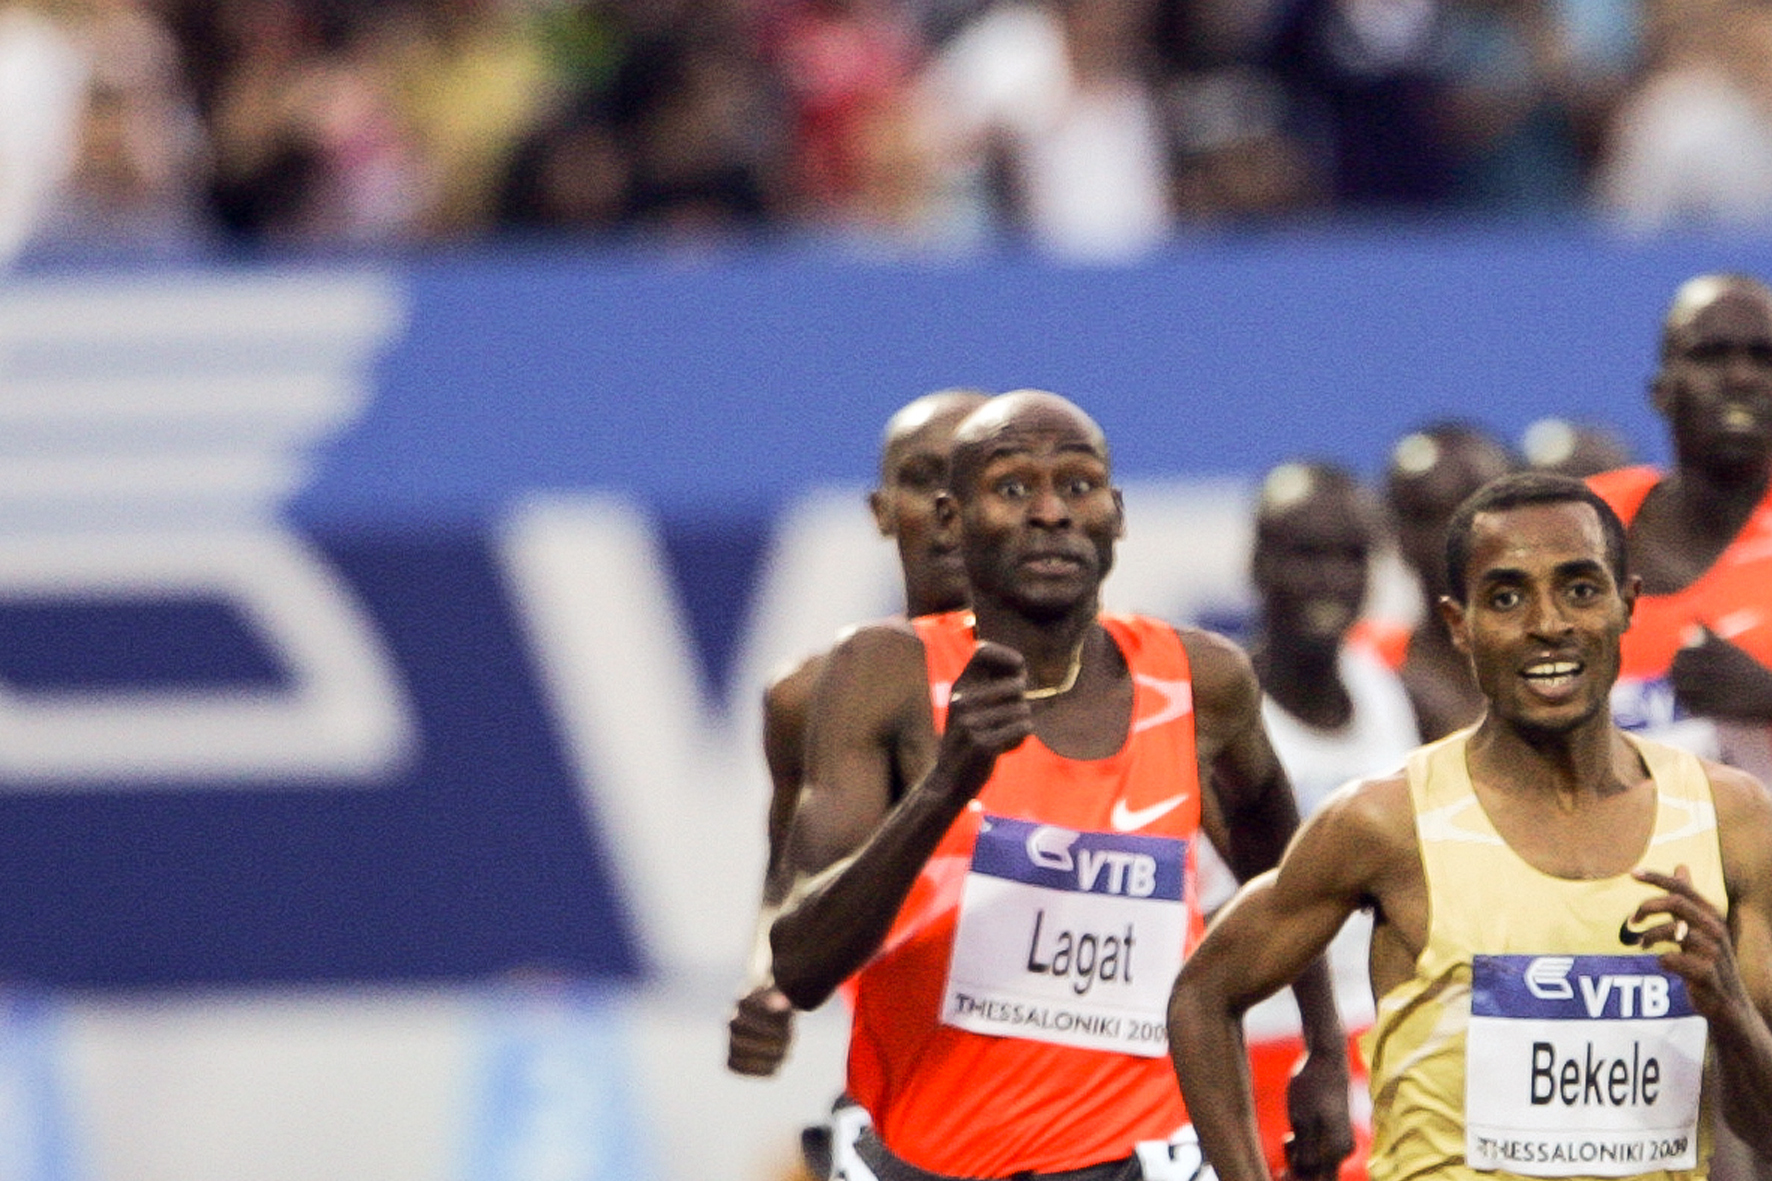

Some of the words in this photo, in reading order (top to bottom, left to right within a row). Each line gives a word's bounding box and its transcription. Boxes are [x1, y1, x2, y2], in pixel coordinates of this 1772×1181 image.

[1077, 849, 1157, 897] VTB
[1027, 908, 1135, 995] Lagat
[956, 993, 1121, 1039] THESSALONIKI
[1127, 1020, 1168, 1042] 200
[1579, 975, 1670, 1018] VTB
[1529, 1040, 1661, 1107] Bekele
[1477, 1136, 1644, 1163] THESSALONIKI
